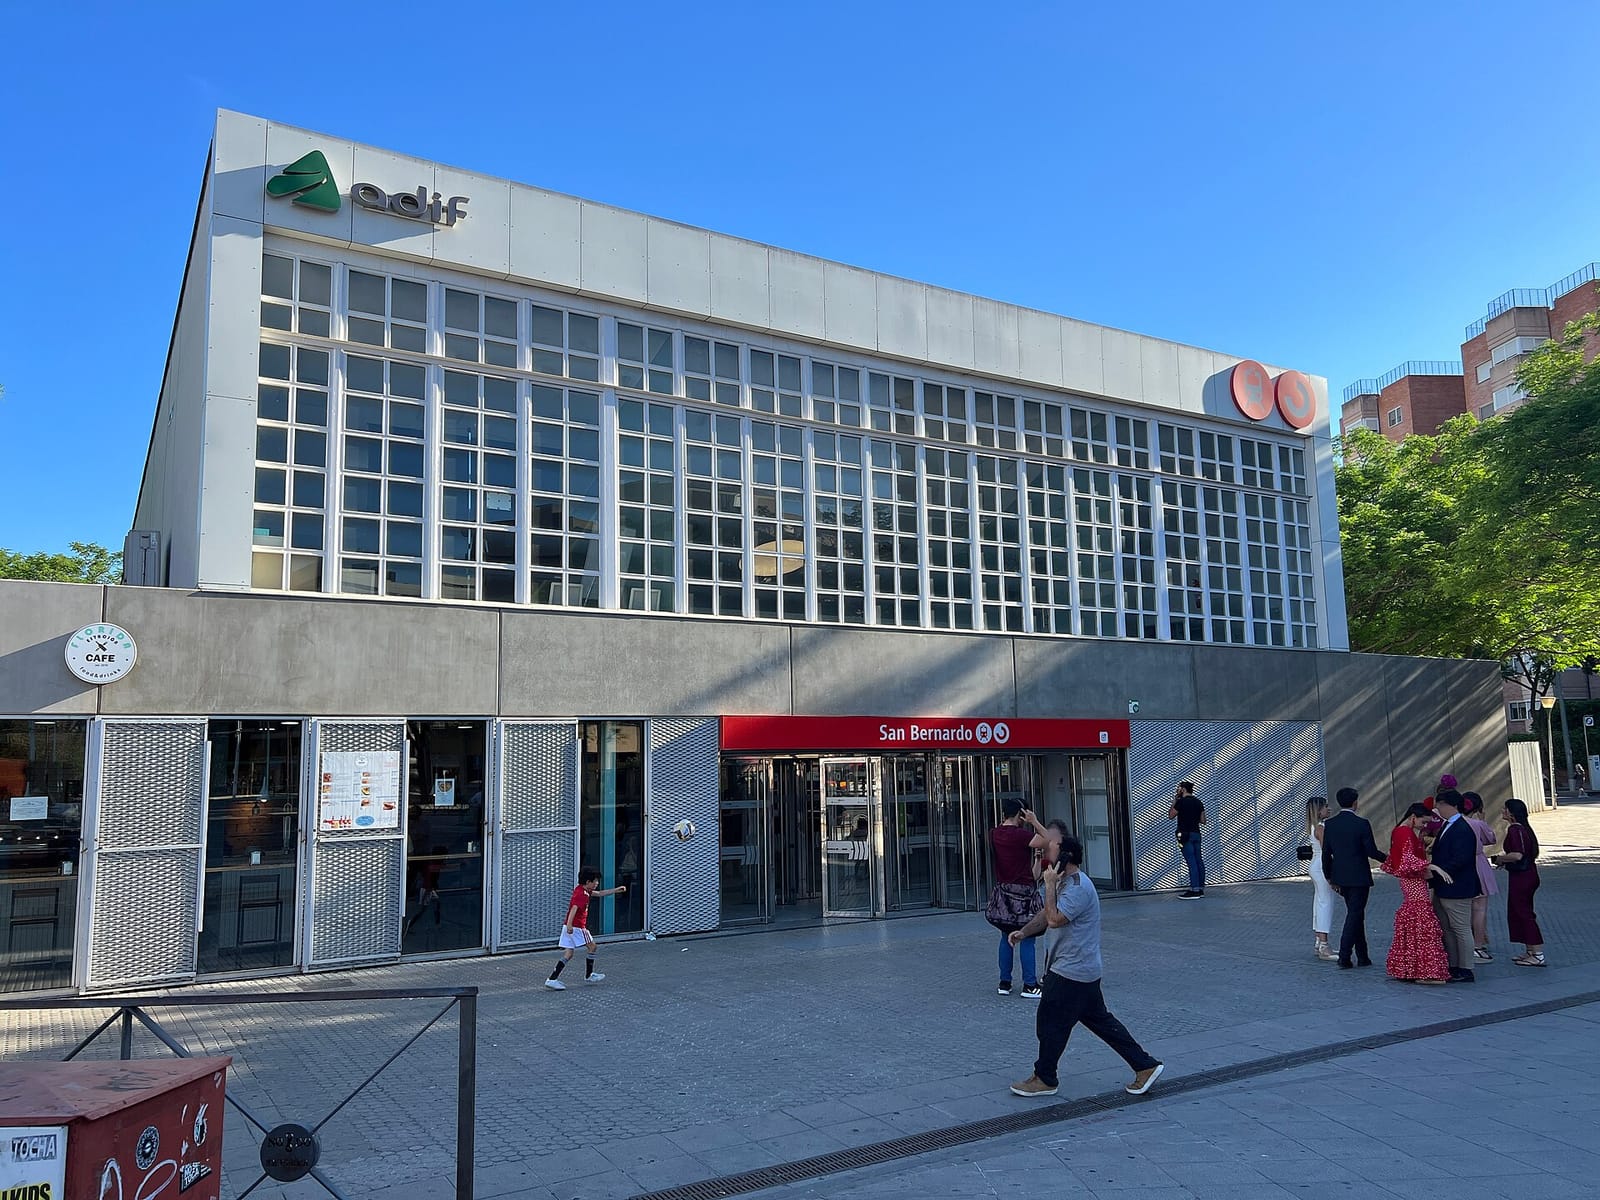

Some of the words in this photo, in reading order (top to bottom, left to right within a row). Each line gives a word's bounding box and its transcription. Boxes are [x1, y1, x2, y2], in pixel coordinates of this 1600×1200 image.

[351, 182, 470, 227] adif
[70, 625, 132, 649] FLORIDA
[85, 654, 115, 662] CAFE
[879, 724, 905, 741] San
[910, 724, 972, 741] Bernardo
